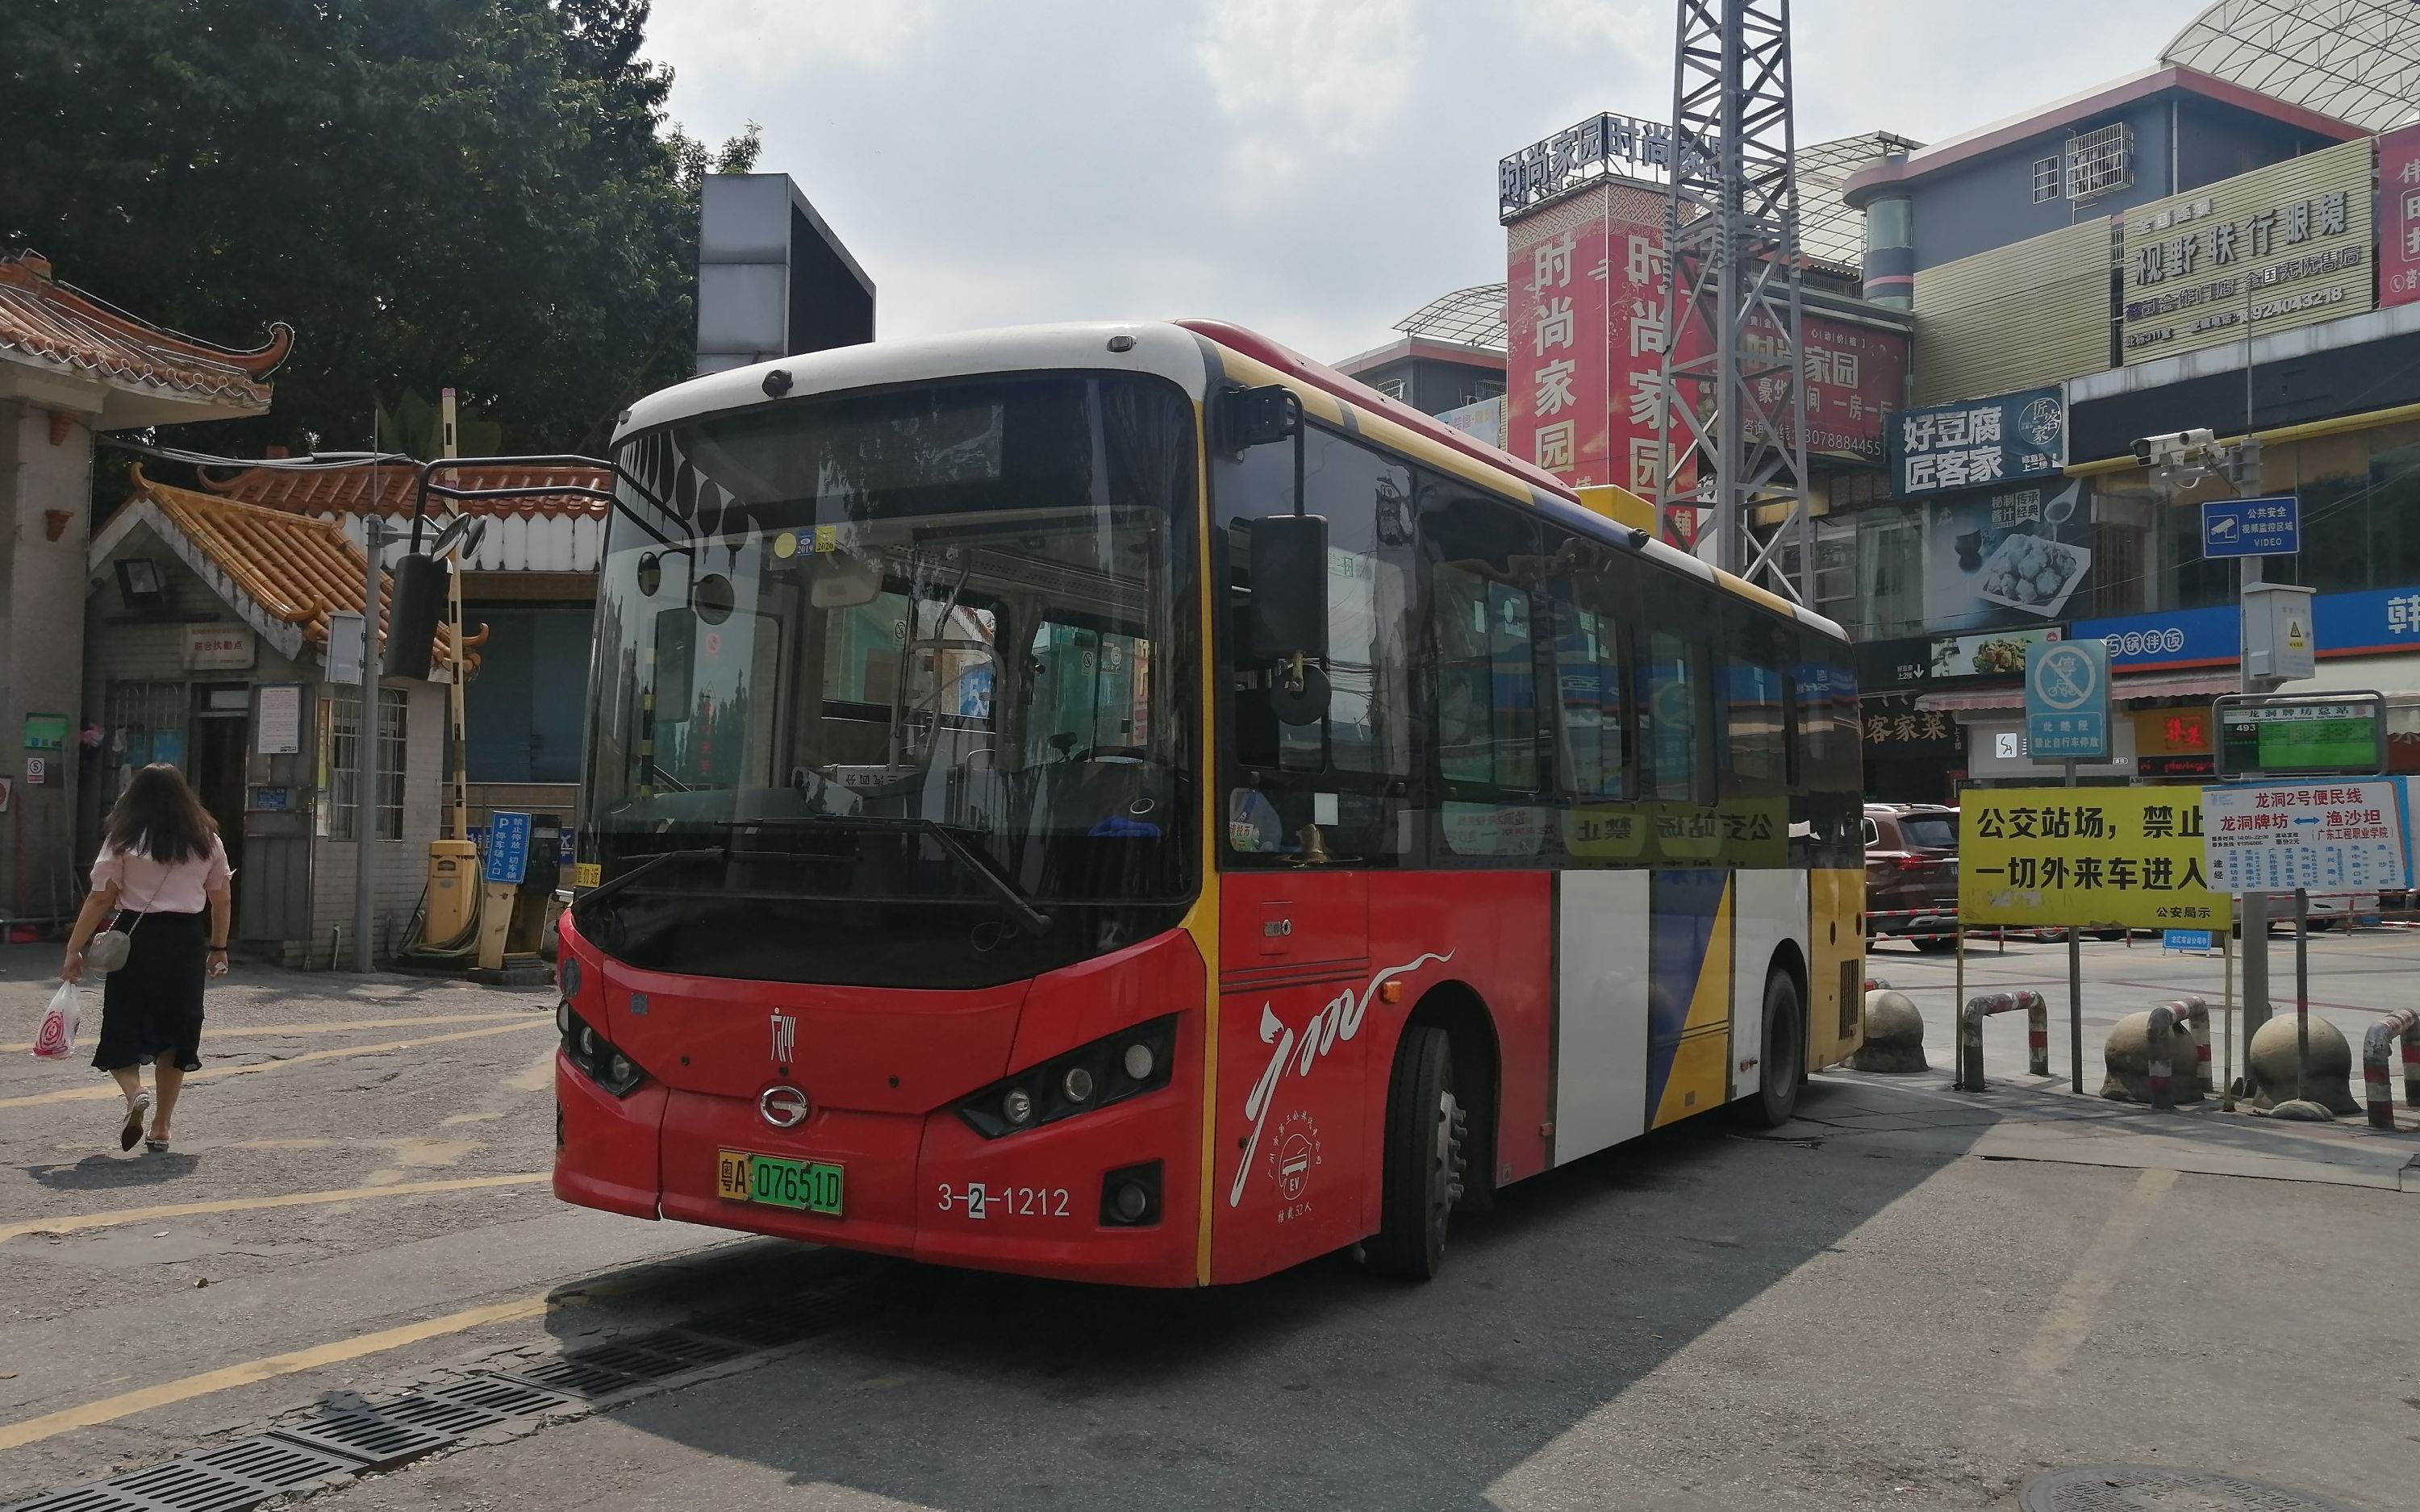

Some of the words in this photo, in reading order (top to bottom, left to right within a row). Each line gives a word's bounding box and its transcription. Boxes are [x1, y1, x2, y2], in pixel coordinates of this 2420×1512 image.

[1499, 115, 1604, 199] 时尚家园
[2138, 198, 2213, 235] 全国连锁
[2137, 192, 2348, 285] 视野联行眼镜
[2243, 245, 2361, 289] 全国无忧售后
[1535, 231, 1577, 474] 时尚家园
[1628, 235, 1679, 497] 时尚家园
[1904, 406, 2001, 454] 好豆腐
[1905, 445, 2004, 494] 匠客家
[2017, 491, 2038, 505] 传承
[2017, 505, 2038, 518] 经典
[2247, 506, 2287, 519] 公共安全
[2242, 521, 2293, 534] 视频监控区域
[797, 545, 813, 554] 2019
[2254, 538, 2282, 547] VIDEO
[2104, 627, 2183, 657] 石锅拌饭
[2249, 706, 2350, 719] 龙洞牌坊总站
[1865, 711, 1948, 744] 客家菜
[2043, 720, 2089, 732] 此路段
[2034, 737, 2099, 749] 禁止自行车停放
[2255, 788, 2364, 809] 龙洞2号便民线
[499, 818, 509, 828] P
[2220, 813, 2289, 832] 龙洞牌坊
[2326, 809, 2382, 827] 渔沙坦
[492, 831, 507, 875] 停车场入口
[507, 818, 523, 879] 禁止停放一切车辆
[1976, 856, 2208, 890] 一切外来车进入
[2213, 859, 2223, 880] 途经
[2156, 906, 2211, 919] 公安局示
[757, 1163, 840, 1207] 07651D
[1290, 1177, 1300, 1193] EV
[938, 1183, 1070, 1217] 3-2-1212
